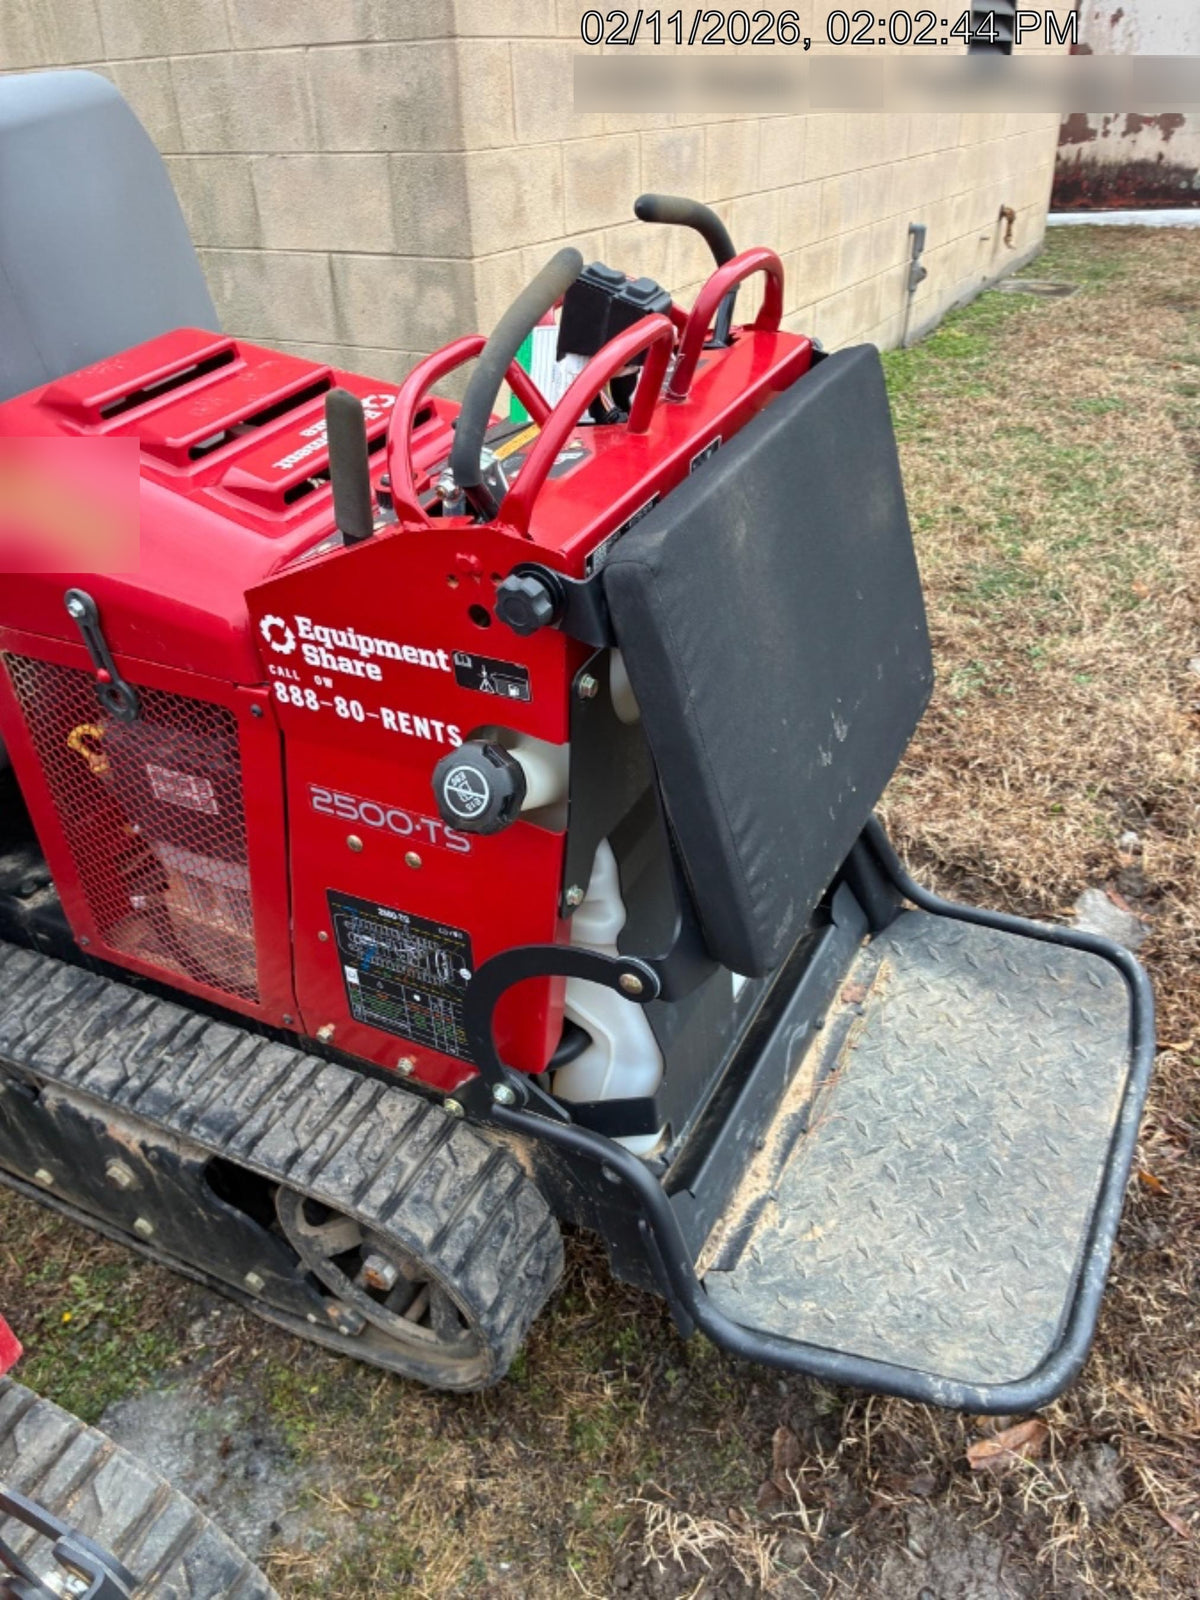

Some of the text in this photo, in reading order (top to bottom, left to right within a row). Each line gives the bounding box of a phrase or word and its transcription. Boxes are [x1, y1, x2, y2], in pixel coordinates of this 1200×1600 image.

[294, 615, 452, 672] Equipment
[301, 643, 383, 681] Share
[268, 664, 301, 681] CALL
[273, 681, 463, 748] 888-80-RENTS
